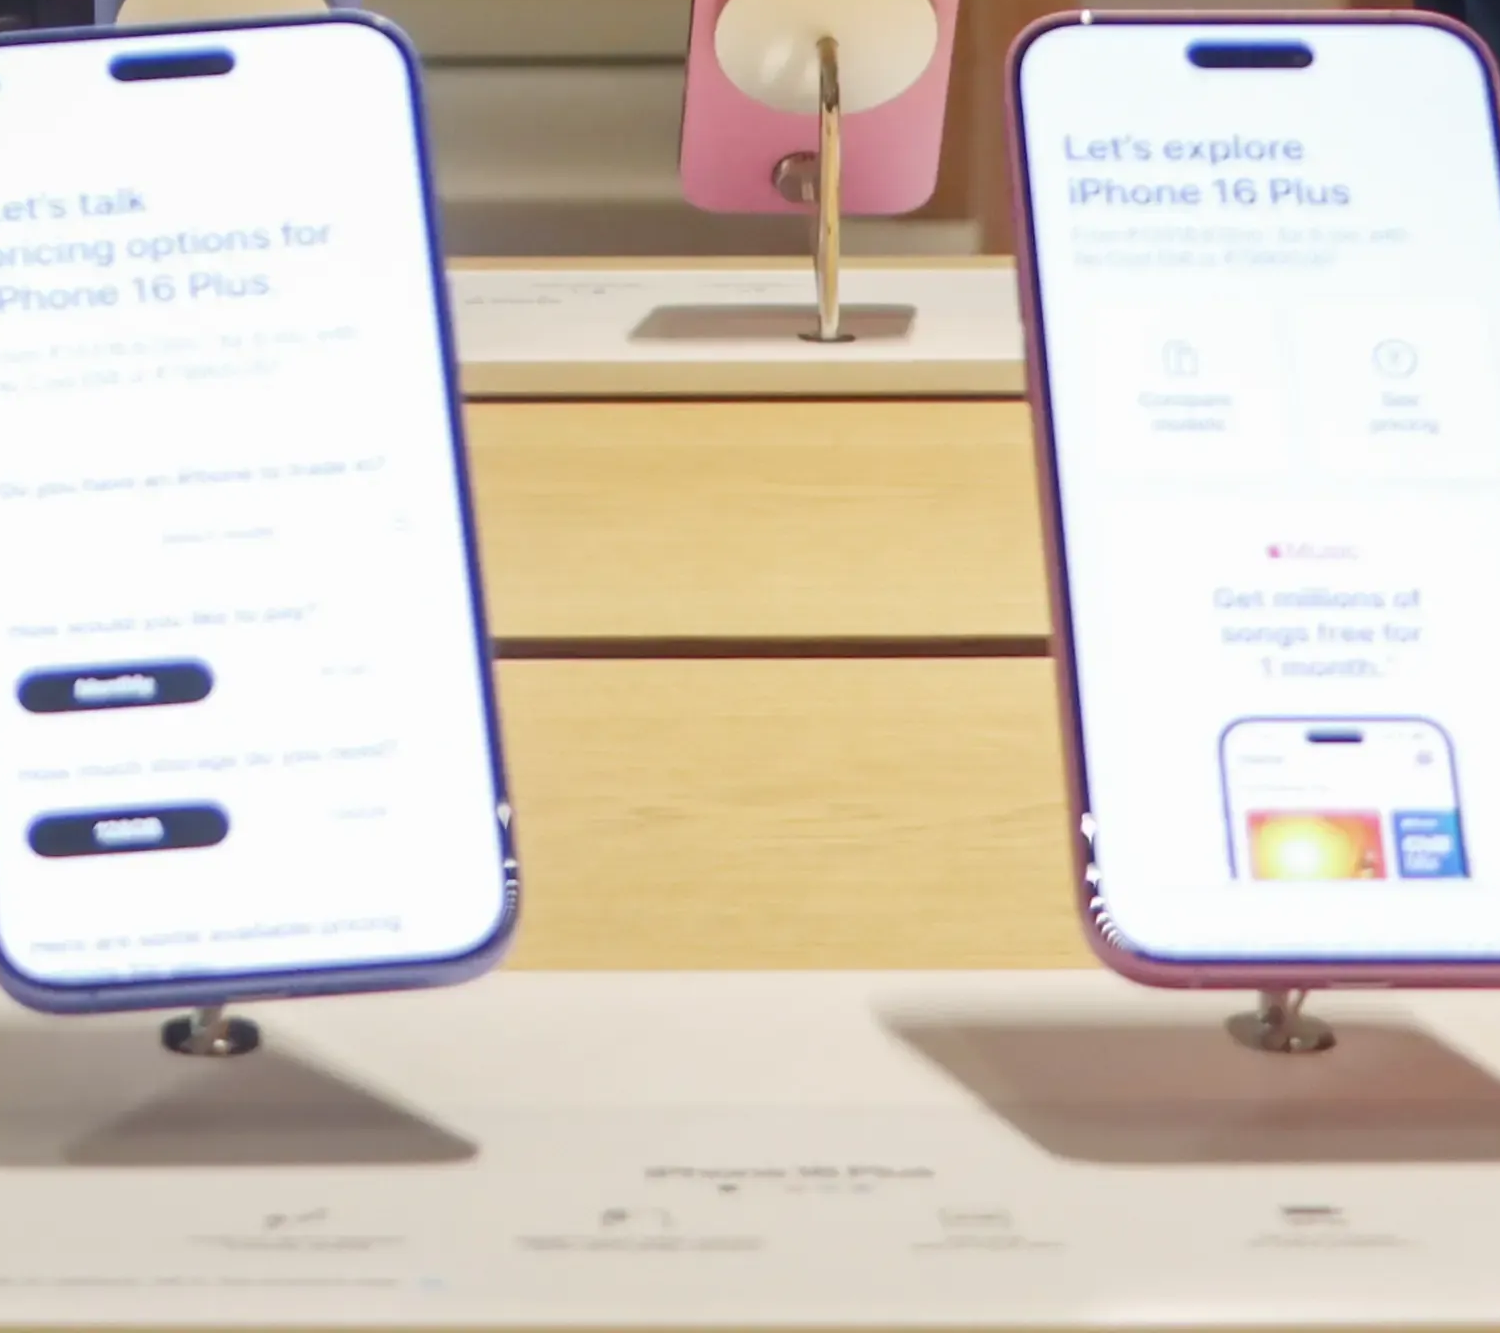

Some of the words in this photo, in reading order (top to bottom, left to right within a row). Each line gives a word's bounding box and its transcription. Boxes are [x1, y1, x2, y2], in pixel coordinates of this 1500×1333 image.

[1063, 132, 1152, 163] Let's
[1162, 134, 1306, 167] explore
[78, 186, 147, 217] talk
[1068, 176, 1202, 208] iPhone
[1212, 176, 1257, 206] 16
[1268, 175, 1352, 207] Plus
[126, 223, 271, 263] options
[280, 218, 332, 248] for
[132, 273, 177, 304] 16
[188, 269, 270, 300] Plus
[1211, 586, 1266, 609] Get
[1271, 586, 1387, 609] millions
[1391, 587, 1422, 609] of
[1219, 624, 1311, 650] songs
[1316, 620, 1376, 643] free
[1380, 621, 1423, 644] for
